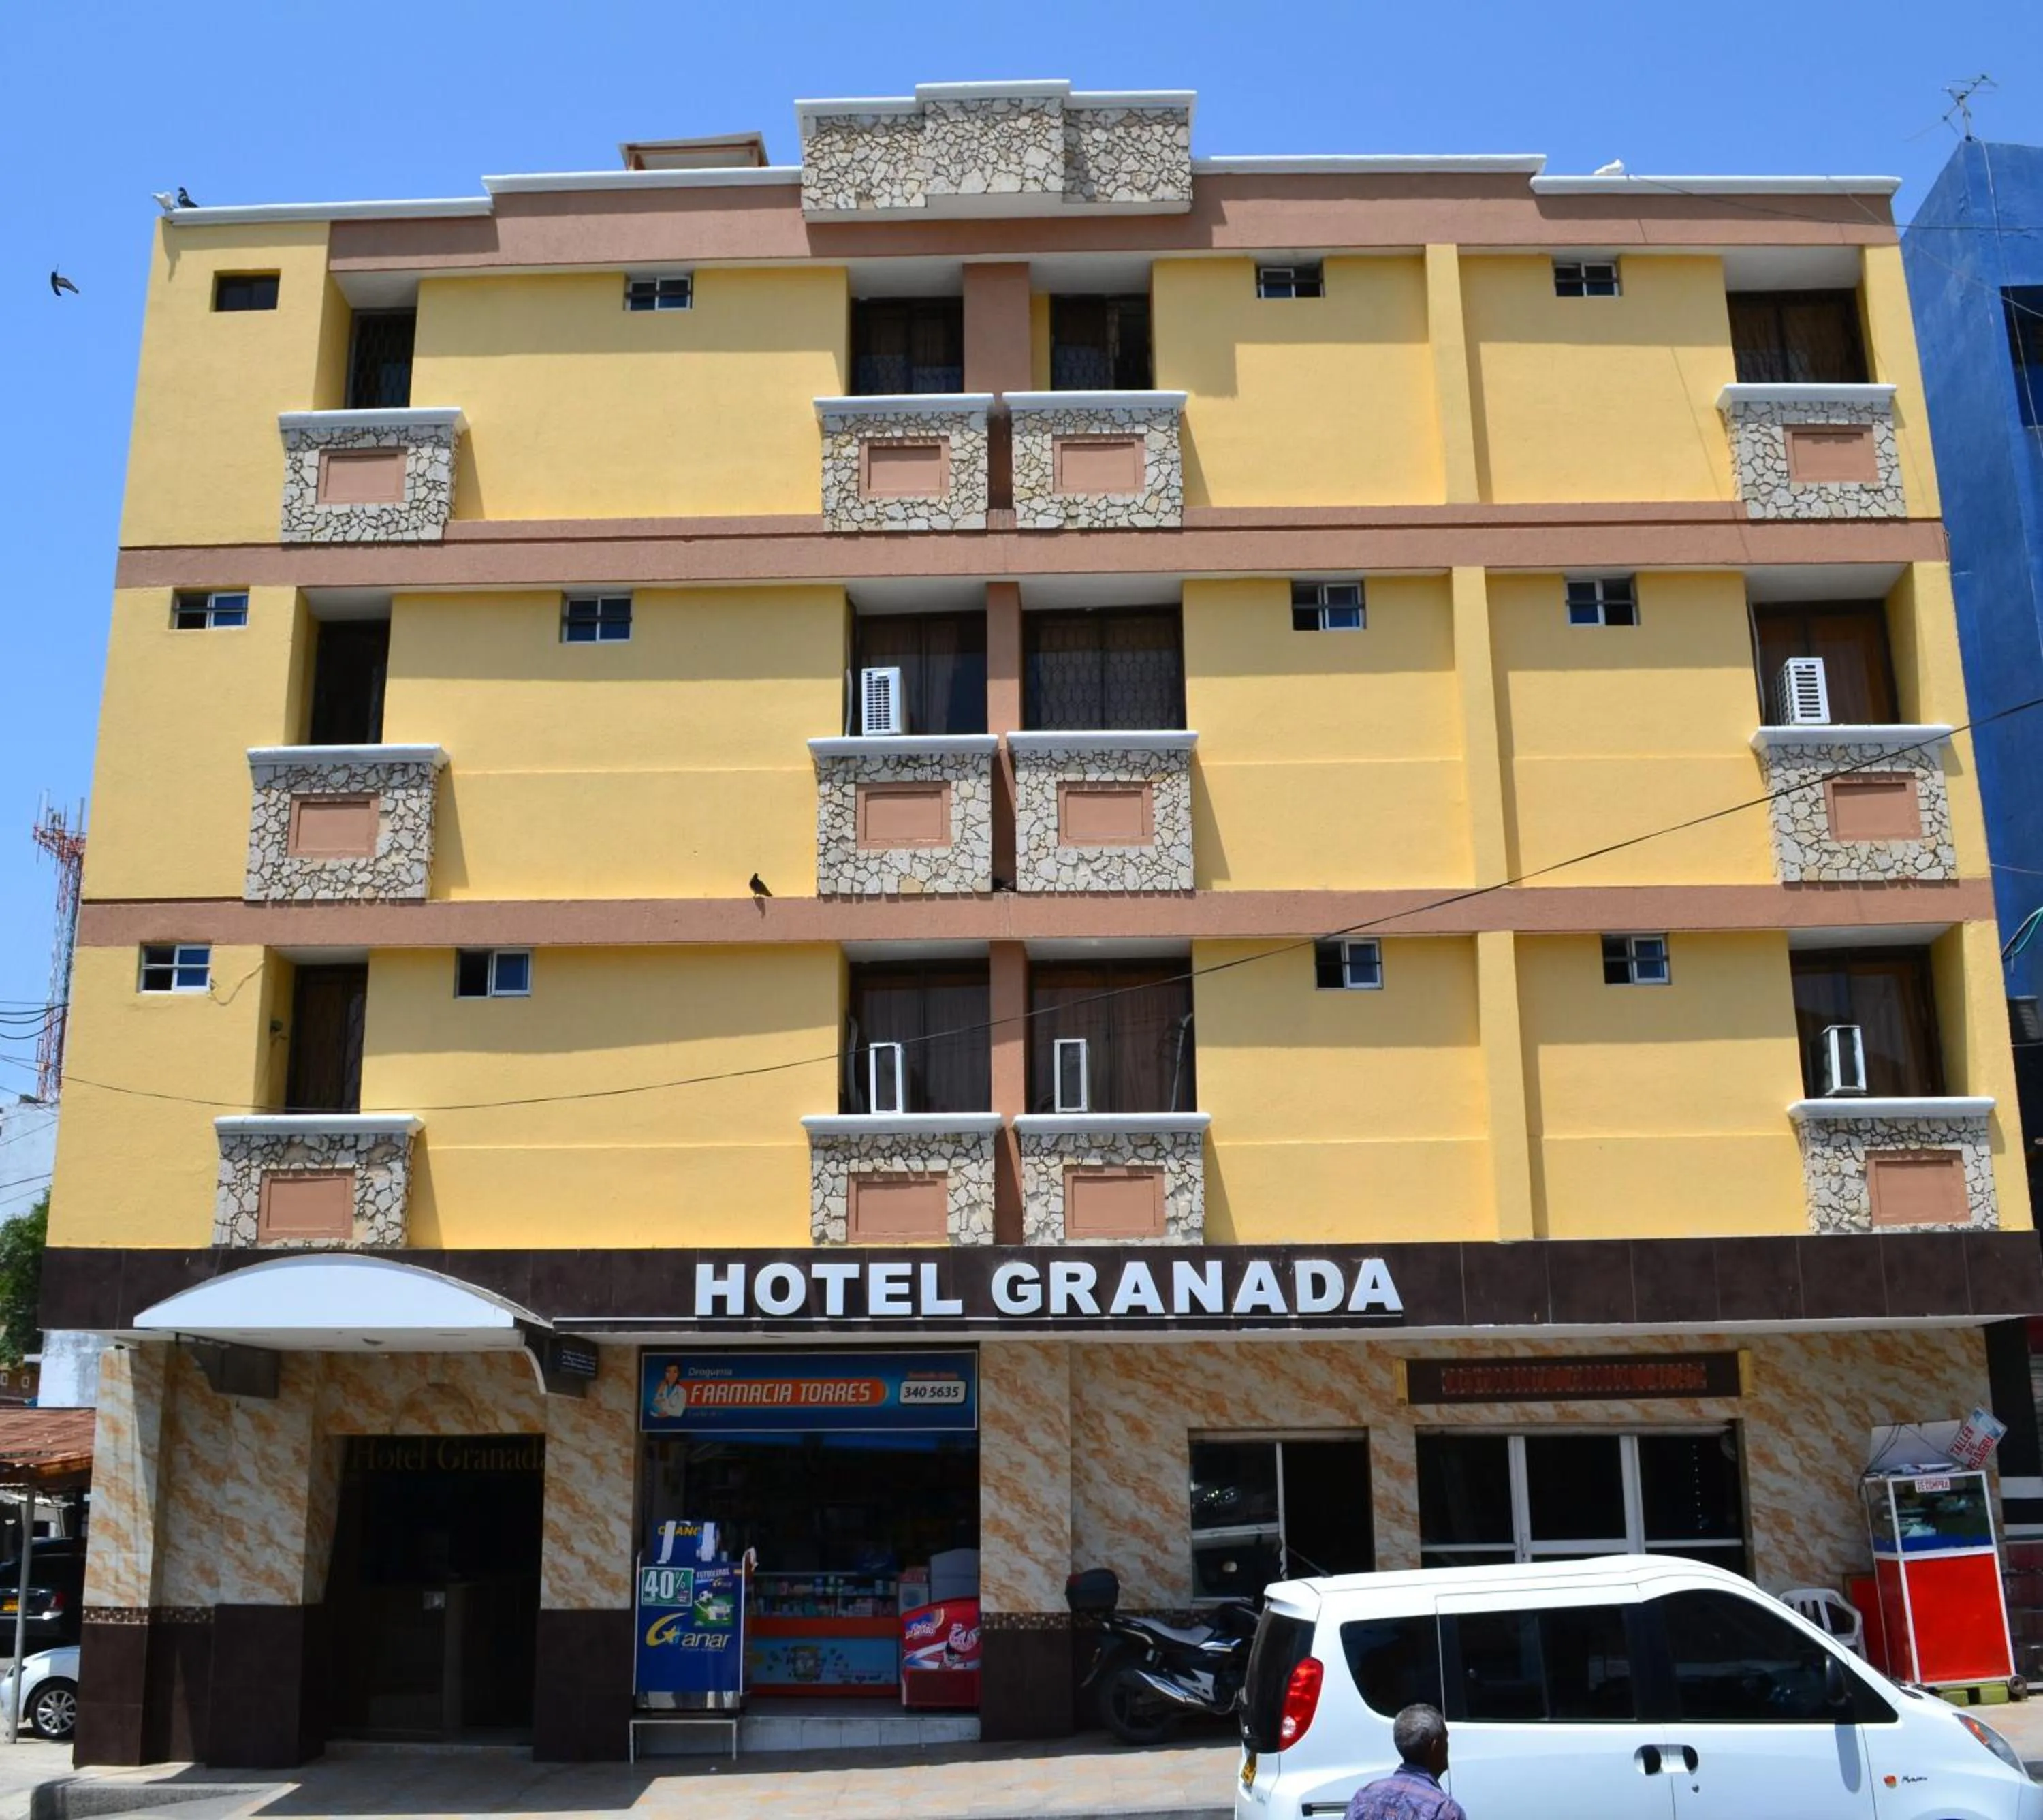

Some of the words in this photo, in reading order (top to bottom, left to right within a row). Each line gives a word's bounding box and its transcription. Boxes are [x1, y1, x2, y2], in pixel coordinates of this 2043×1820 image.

[694, 1261, 963, 1316] HOTEL
[990, 1258, 1404, 1316] GRANADA
[690, 1383, 792, 1403] FARMACIA
[800, 1382, 872, 1402] TORRES
[904, 1385, 927, 1398] 340
[928, 1385, 960, 1398] 5635
[353, 1435, 426, 1471] Hotel
[1950, 1425, 1975, 1456] TALLER
